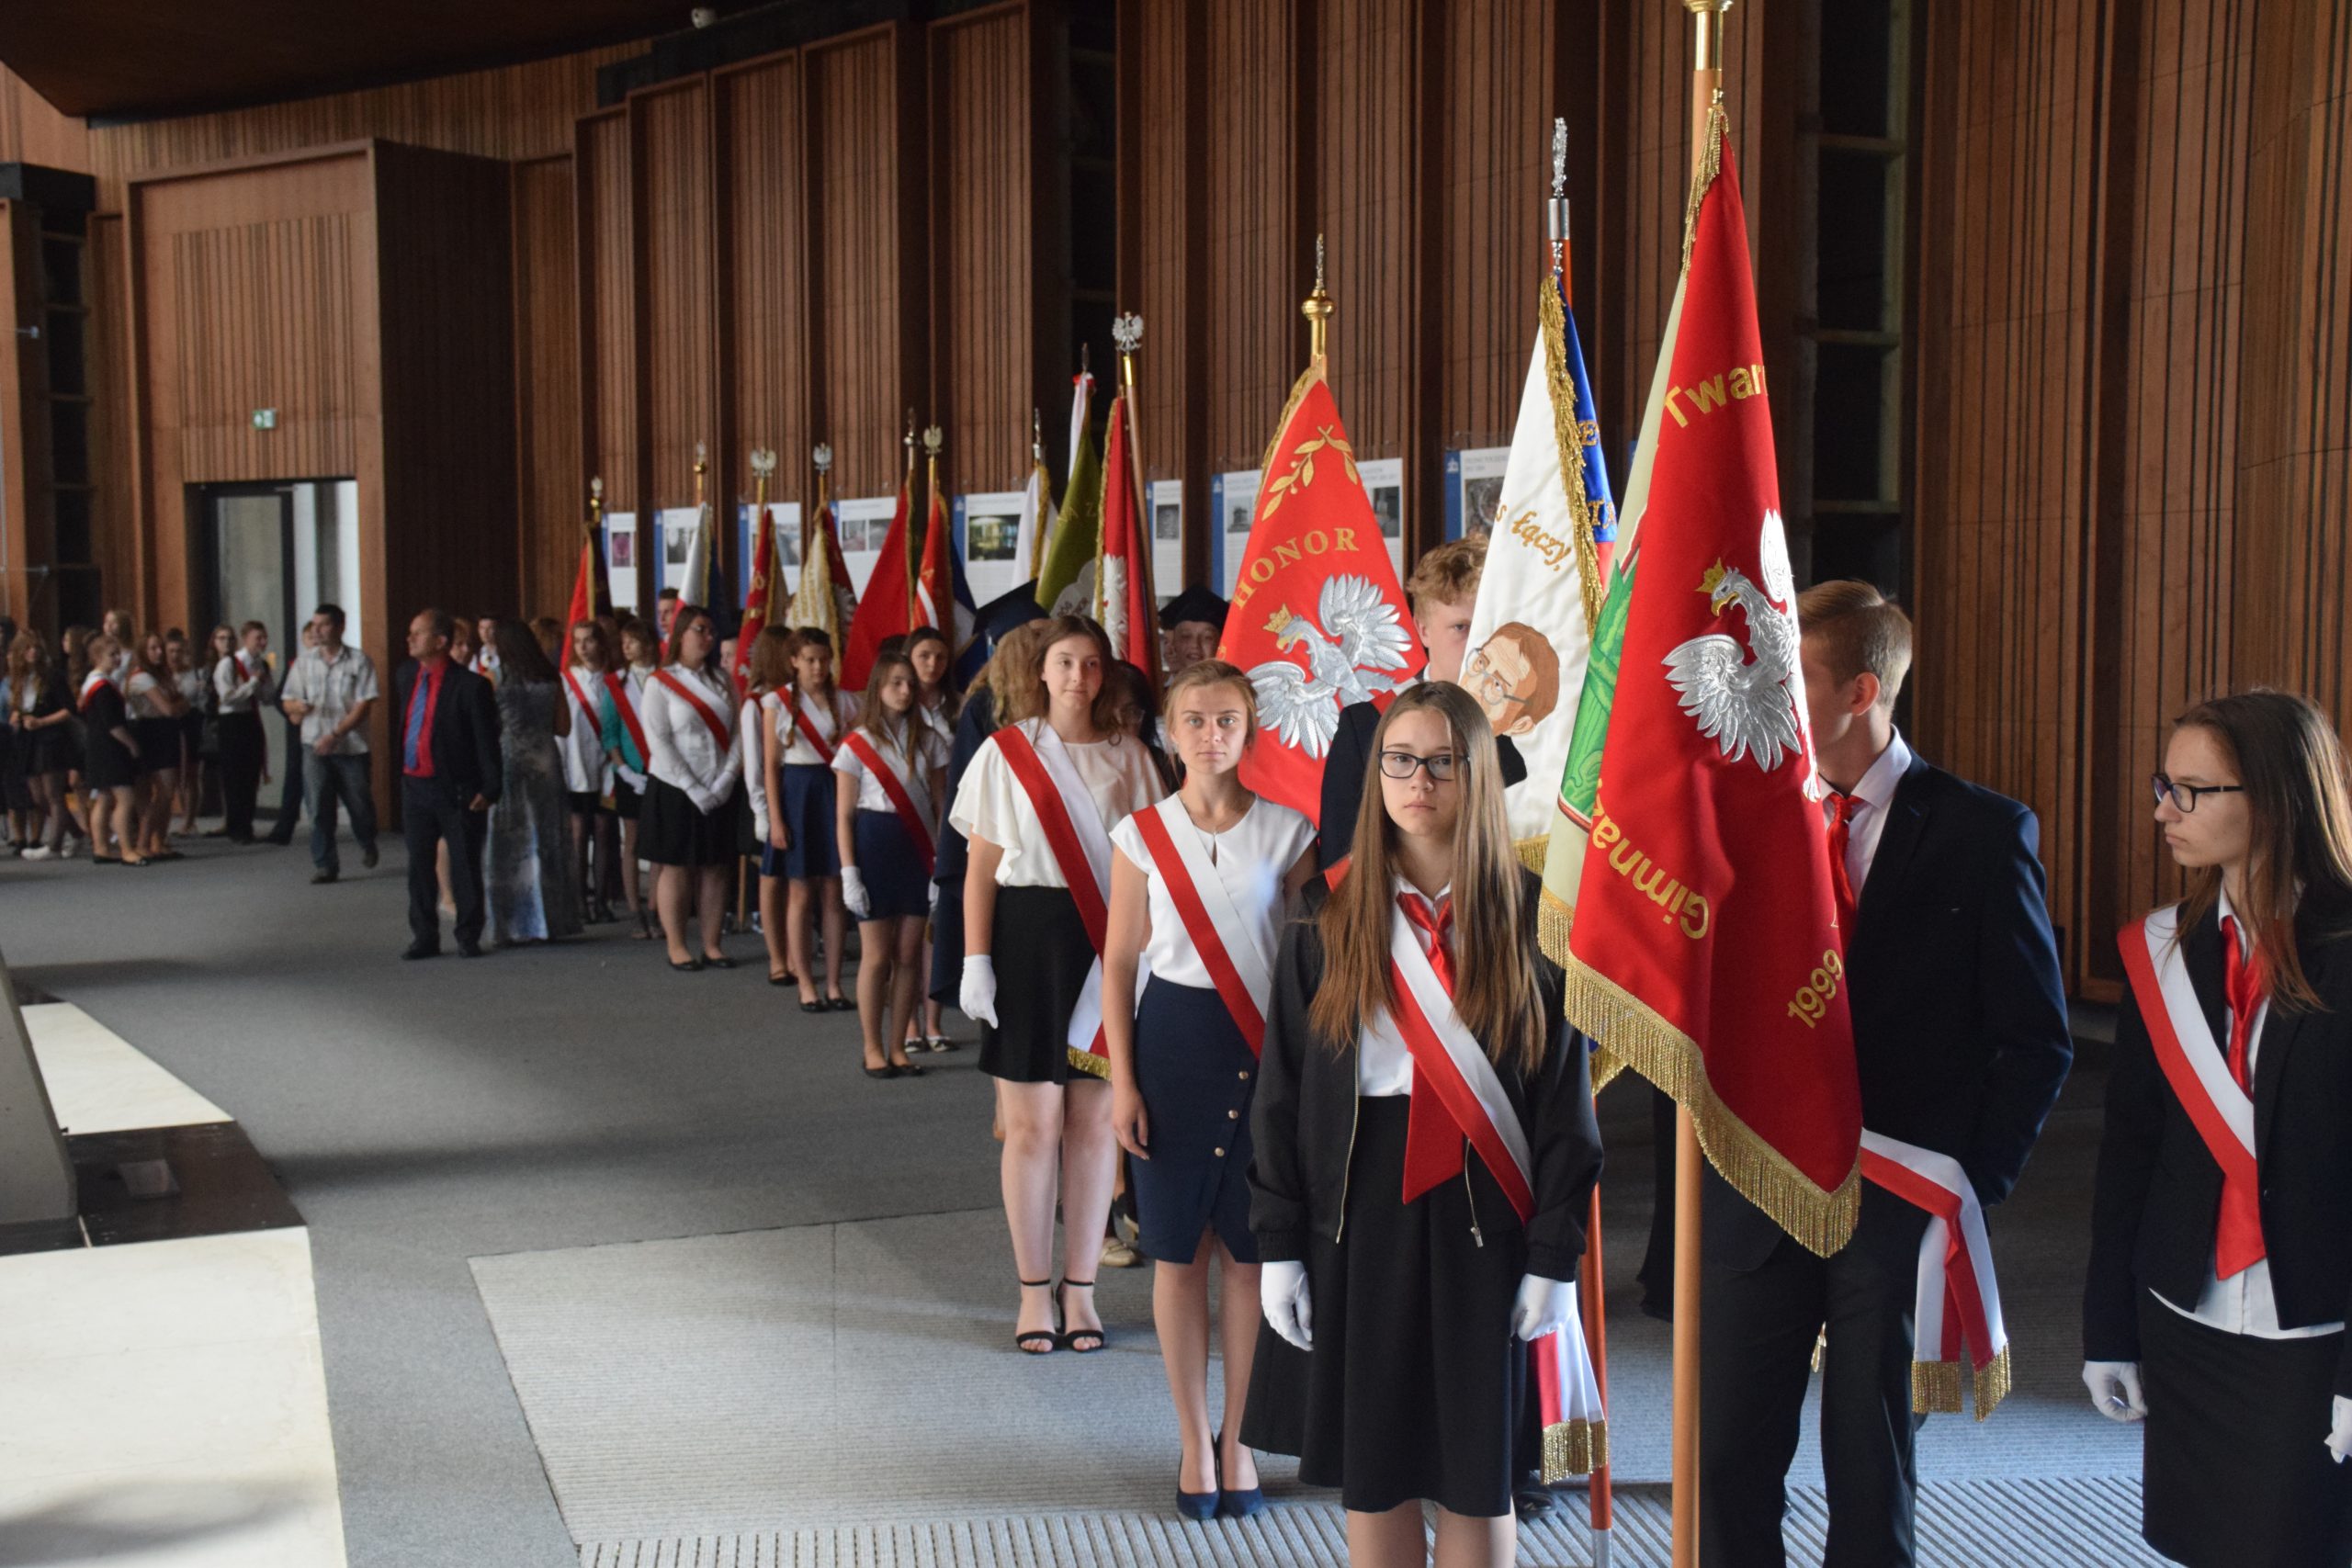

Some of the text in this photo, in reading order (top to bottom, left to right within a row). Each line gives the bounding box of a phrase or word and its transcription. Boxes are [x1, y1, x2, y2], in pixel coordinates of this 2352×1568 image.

[1665, 364, 1768, 429] Twar
[1233, 526, 1360, 611] HONOR
[1787, 948, 1843, 1029] 1999
